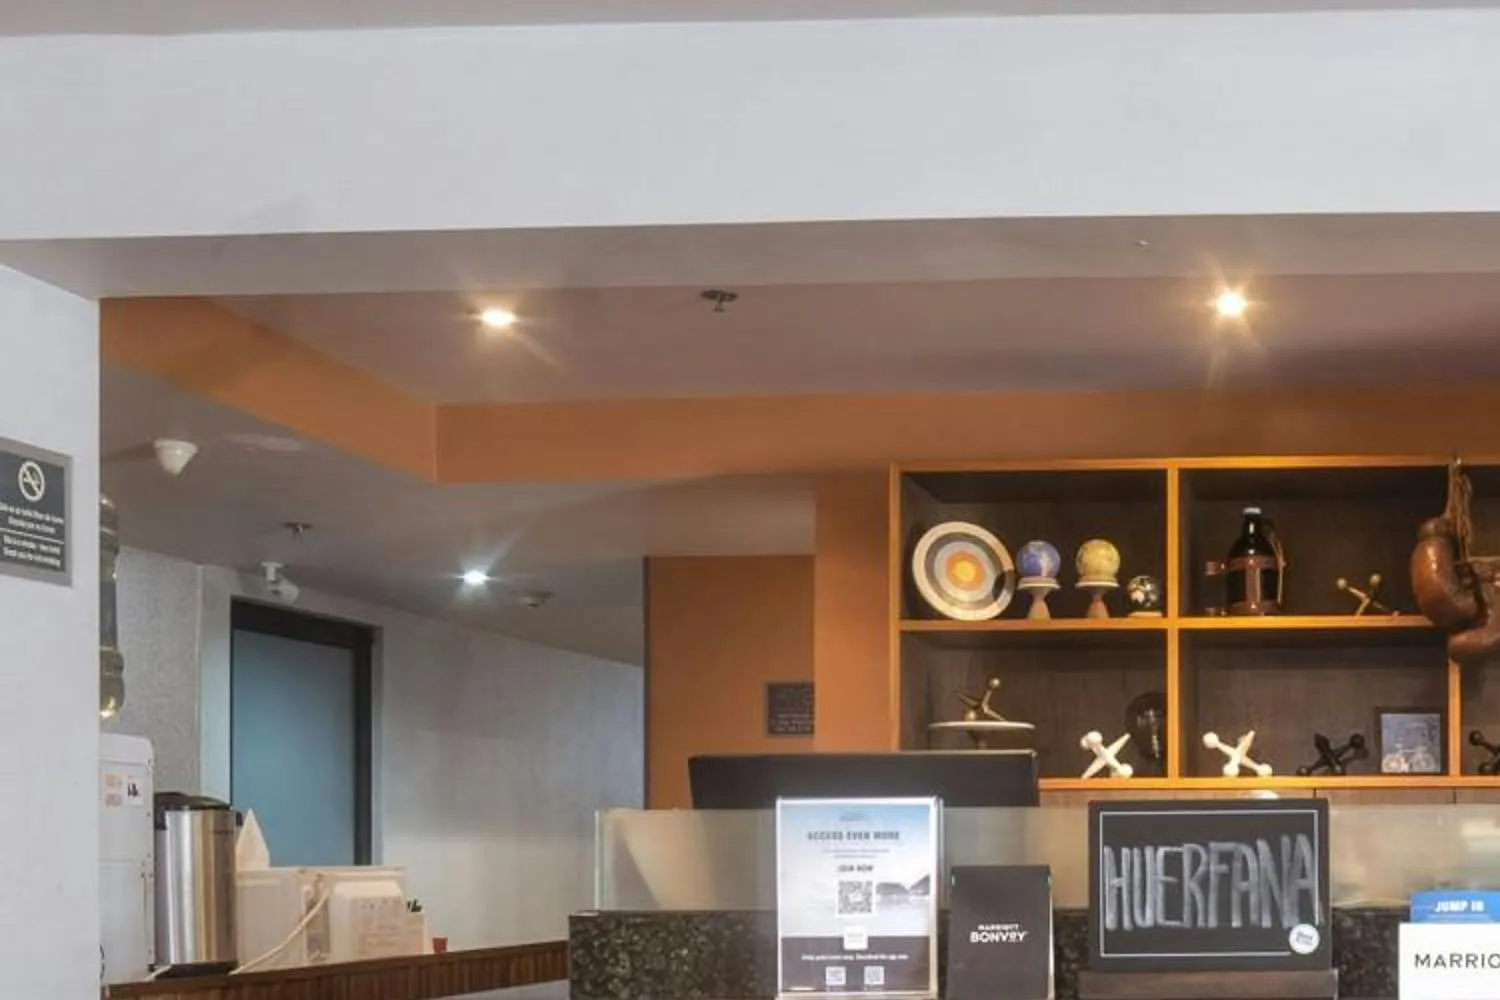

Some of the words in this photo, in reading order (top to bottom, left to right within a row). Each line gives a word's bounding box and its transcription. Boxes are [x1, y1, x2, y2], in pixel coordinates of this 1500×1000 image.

[1103, 833, 1325, 931] HUERFANA
[1435, 900, 1468, 913] JUMP
[970, 931, 1029, 943] BONVOY
